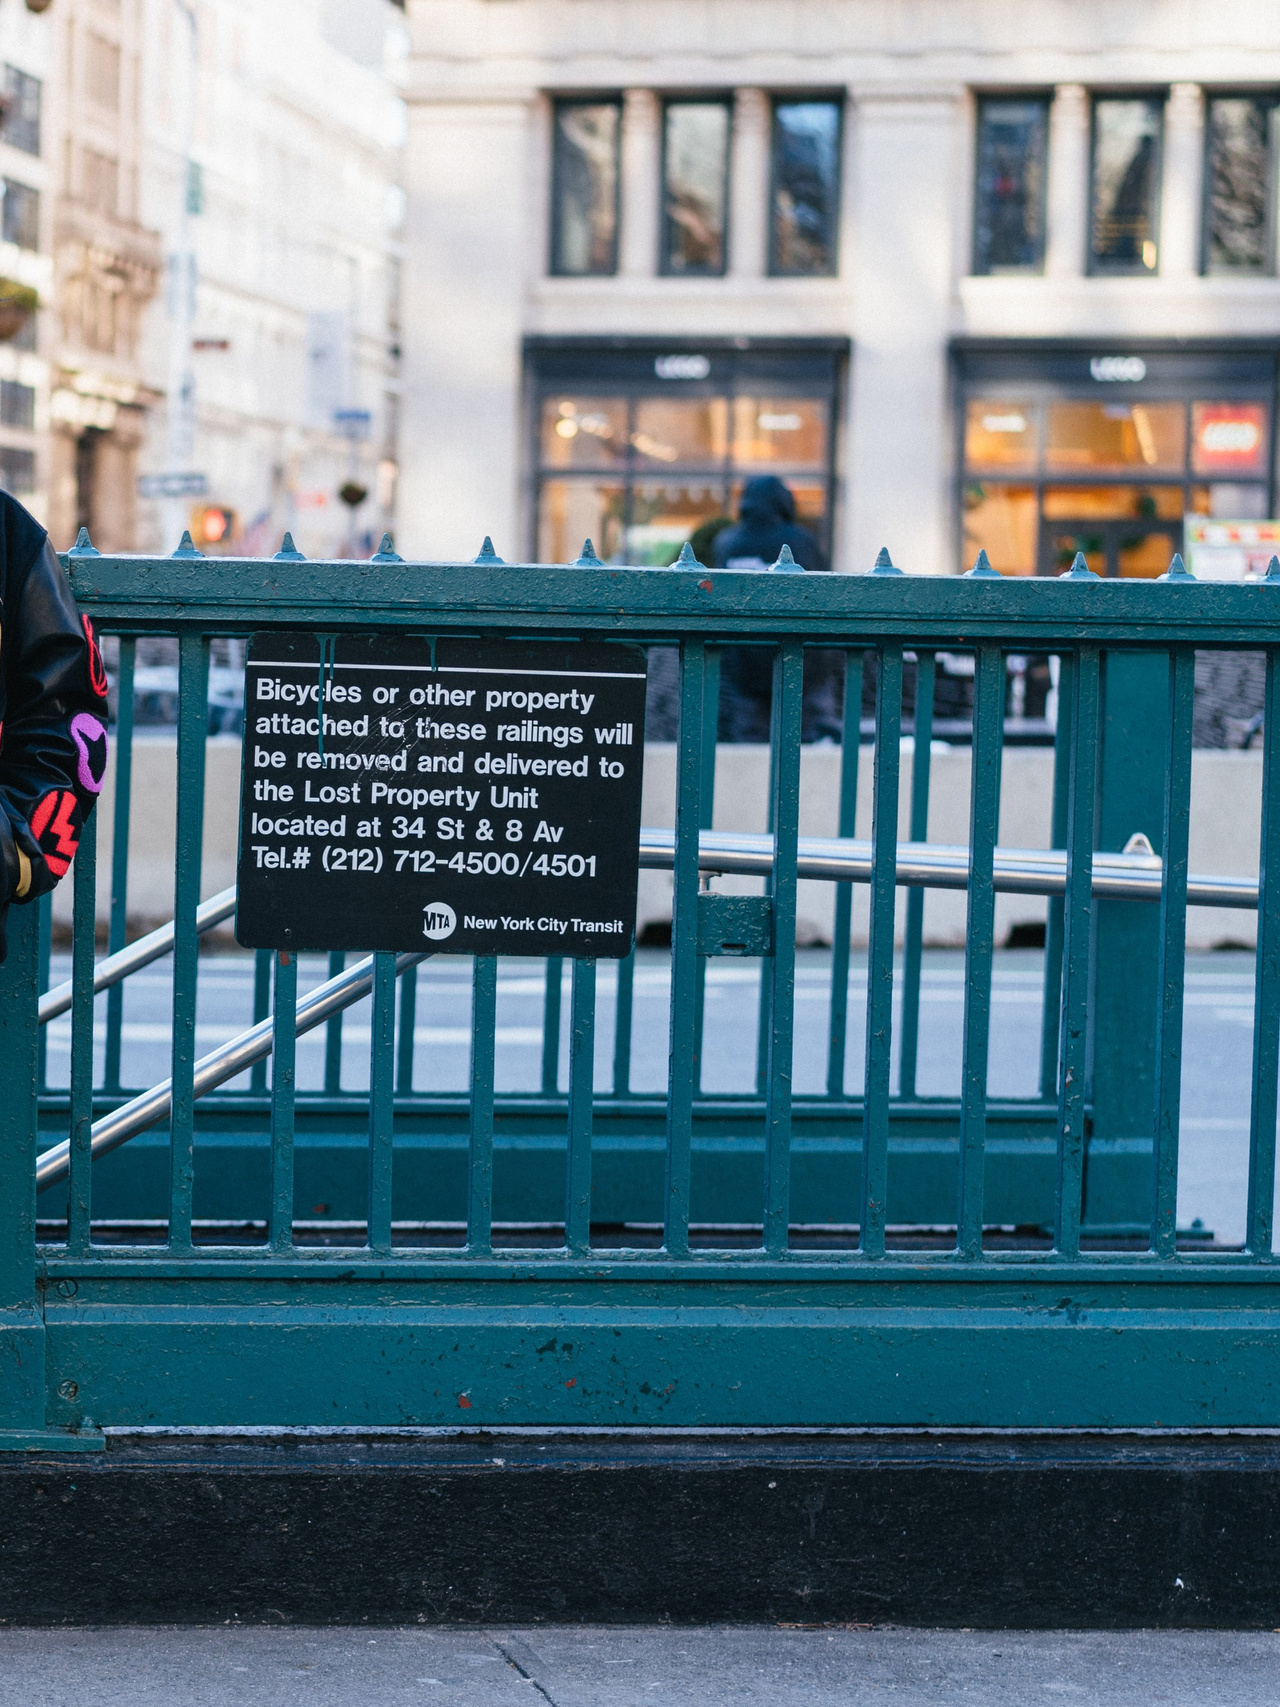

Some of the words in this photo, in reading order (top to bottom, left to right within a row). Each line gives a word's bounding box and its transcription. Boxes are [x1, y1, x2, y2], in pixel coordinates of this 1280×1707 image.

[256, 677, 362, 706] Bicycles
[372, 686, 400, 704] or
[409, 683, 476, 706] other
[485, 689, 595, 715] property
[255, 713, 369, 737] attached
[379, 716, 405, 739] to
[415, 716, 487, 741] these
[496, 720, 584, 748] railings
[594, 722, 633, 745] will
[253, 745, 287, 769] be
[296, 749, 408, 772] removed
[417, 751, 464, 773] and
[474, 752, 589, 778] delivered
[598, 756, 625, 779] to
[253, 779, 295, 802] the
[304, 780, 361, 804] Lost
[371, 782, 480, 811] Property
[490, 785, 539, 809] Unit
[251, 812, 346, 837] located
[356, 816, 382, 838] at
[391, 816, 426, 839] 34
[436, 816, 465, 841] St
[475, 818, 494, 841] &
[505, 819, 523, 842] 8
[532, 820, 564, 843] Av
[251, 845, 312, 869] Tel.#
[321, 845, 384, 873] (212)
[393, 850, 597, 878] 712-4500/4501
[423, 910, 450, 932] MTA
[463, 915, 498, 930] New
[500, 916, 535, 931] York
[537, 917, 569, 935] City
[570, 918, 624, 934] Transit
